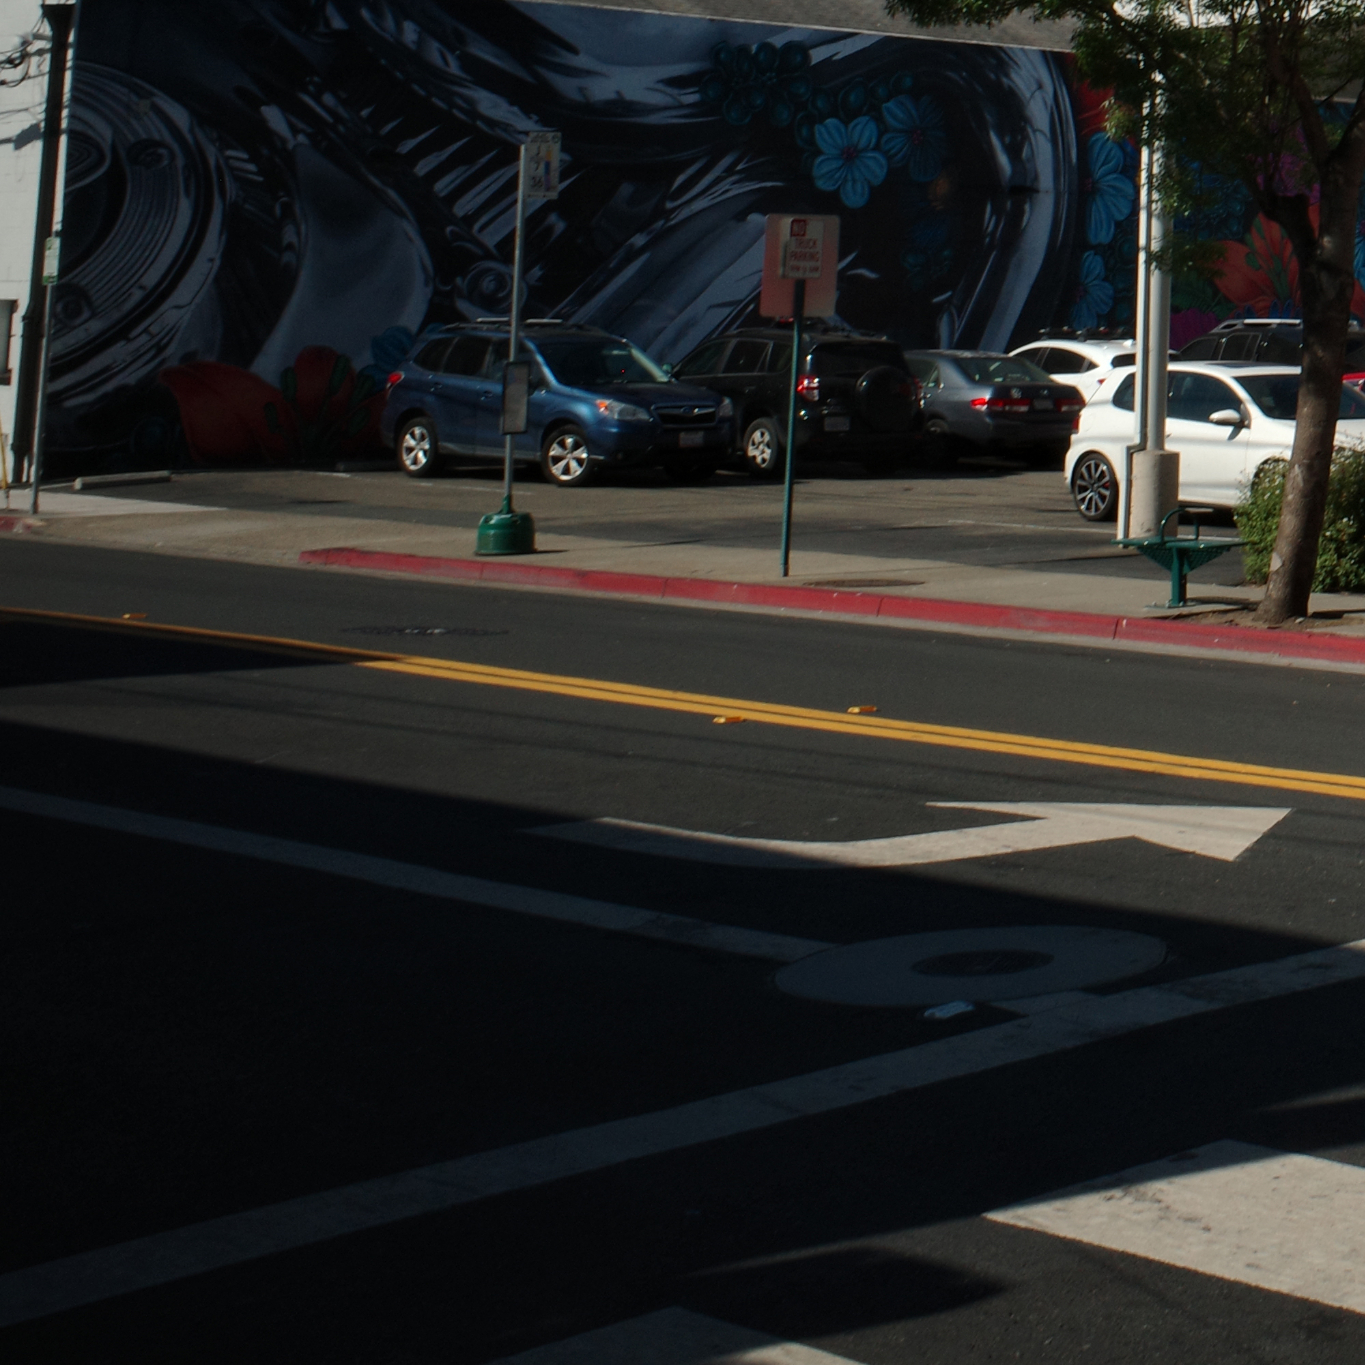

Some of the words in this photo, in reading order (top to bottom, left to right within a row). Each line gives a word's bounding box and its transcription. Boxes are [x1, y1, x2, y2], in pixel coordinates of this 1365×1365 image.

[792, 221, 805, 236] NO
[795, 238, 818, 249] TRUCK
[789, 251, 820, 262] PARKING
